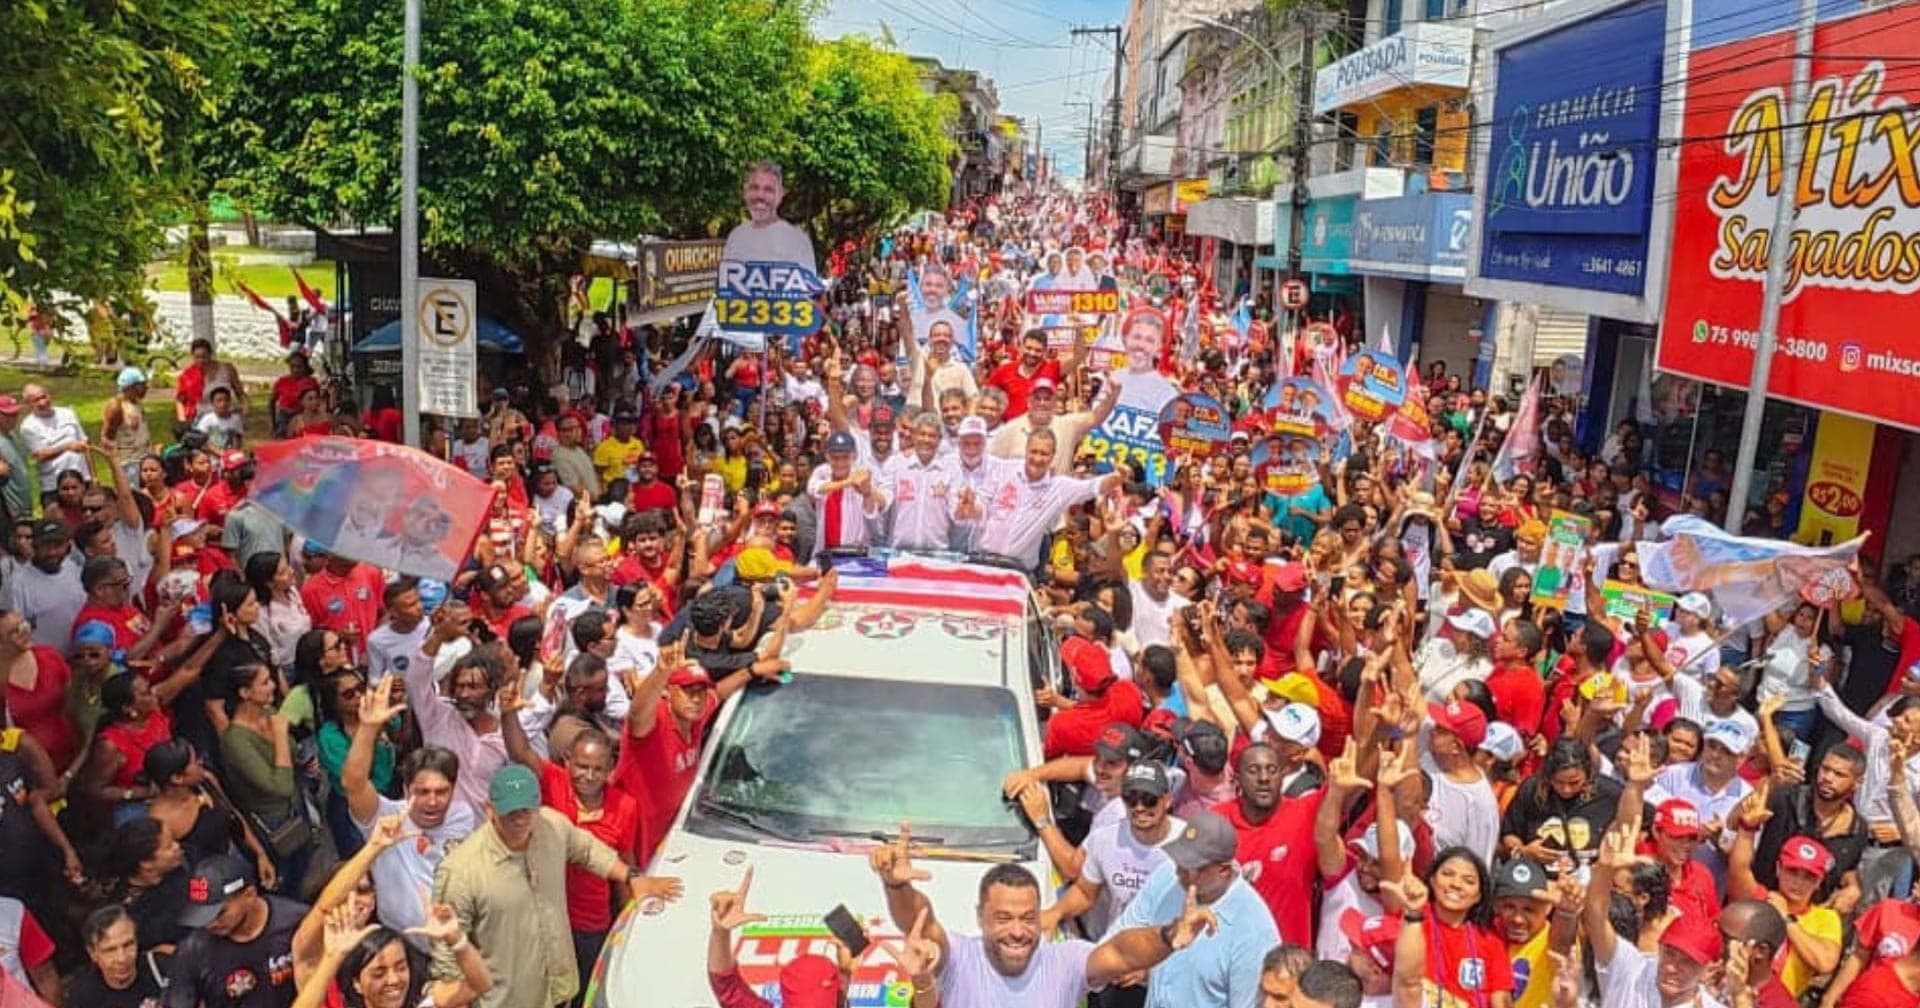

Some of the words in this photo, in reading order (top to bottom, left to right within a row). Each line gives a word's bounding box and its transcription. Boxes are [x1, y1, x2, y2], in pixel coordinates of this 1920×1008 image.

[1337, 36, 1407, 89] POUSADA
[1536, 84, 1637, 127] FARMÁCIA
[1713, 70, 1920, 208] Mix
[1526, 130, 1634, 206] União
[1715, 206, 1920, 294] Sagados
[718, 261, 809, 296] RAFA
[715, 299, 813, 328] 12333
[1732, 329, 1827, 361] 998-3800
